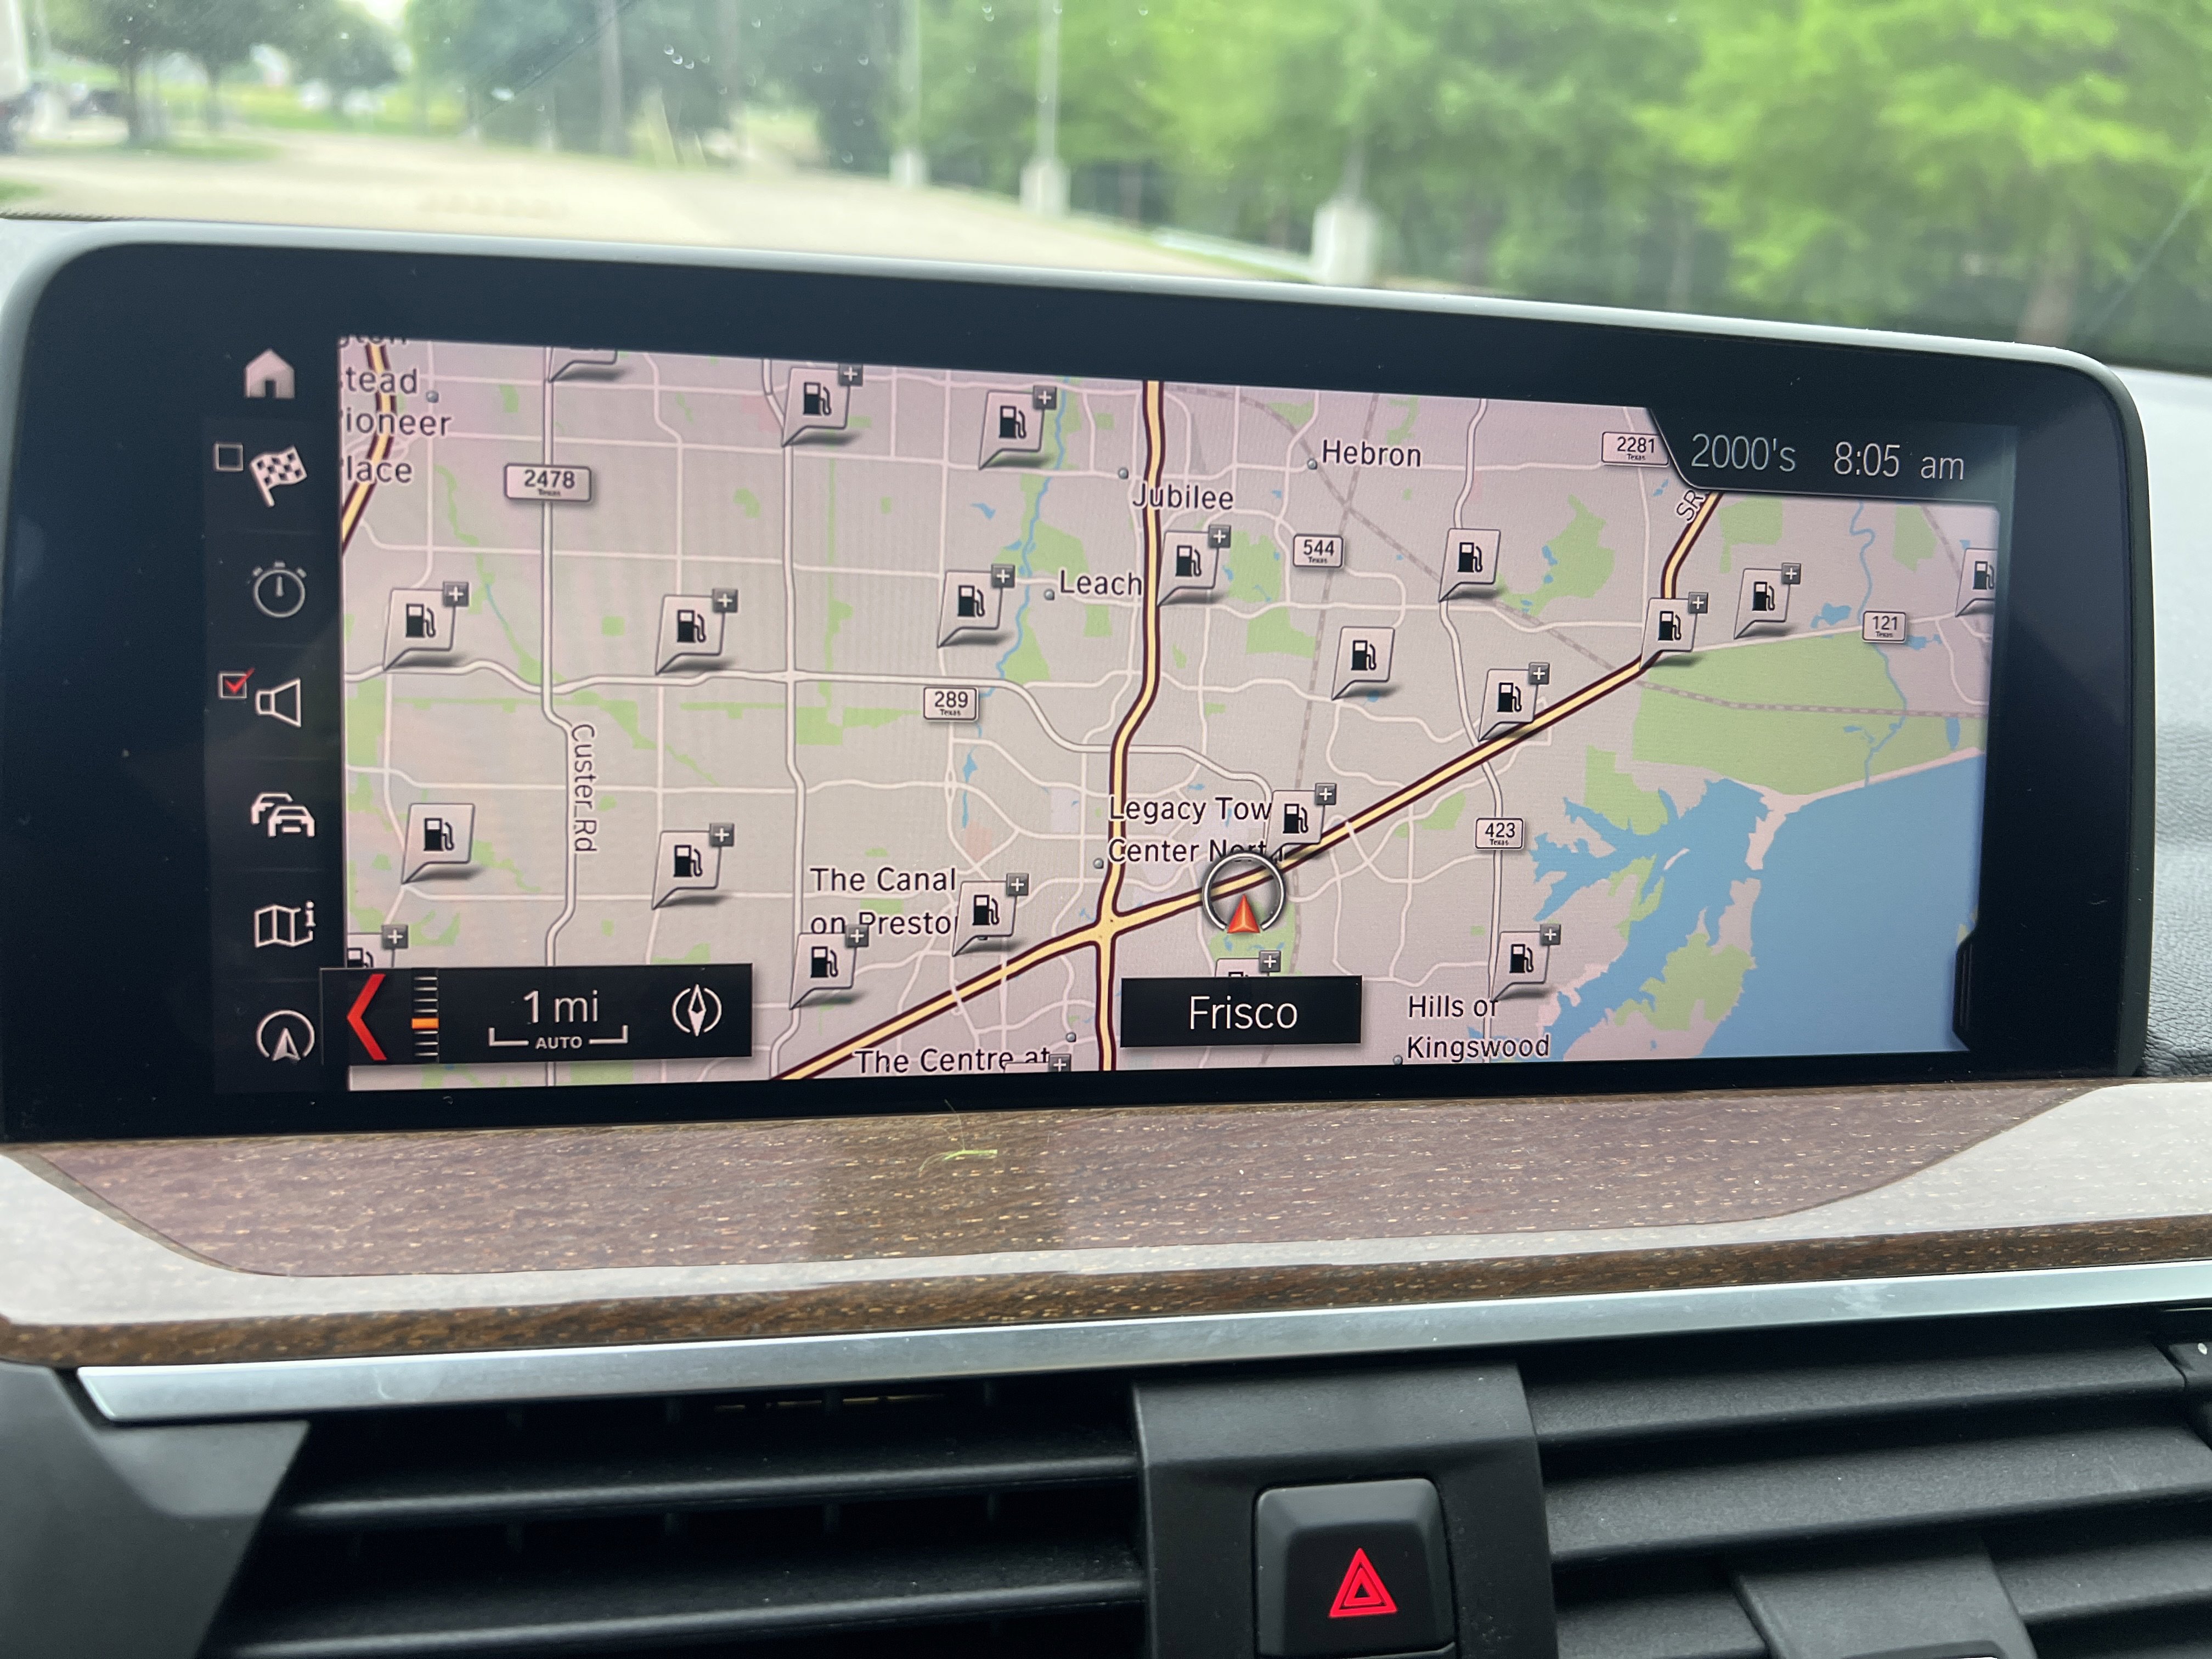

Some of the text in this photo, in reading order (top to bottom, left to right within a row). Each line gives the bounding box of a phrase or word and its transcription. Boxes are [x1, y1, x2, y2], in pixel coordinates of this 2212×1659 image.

[341, 366, 417, 394] tead
[341, 407, 452, 436] ioneer
[1323, 439, 1421, 467] Hebron
[1617, 436, 1655, 453] 2281
[1691, 433, 1796, 472] 2000's
[341, 455, 412, 483] lace
[1834, 441, 1964, 480] 8:05 am
[524, 469, 575, 489] 2478
[1133, 483, 1234, 510] Jubilee
[1304, 539, 1334, 556] 544
[1059, 569, 1143, 595] Leach
[1872, 616, 1897, 630] 121
[935, 691, 968, 708] 289
[572, 724, 597, 851] Custer Rd
[1109, 797, 1206, 824] Legacy
[1485, 822, 1515, 838] 423
[1109, 839, 1199, 862] Center
[810, 867, 956, 891] The Canal
[811, 912, 959, 934] on Presto
[523, 990, 597, 1023] 1 mi
[1189, 996, 1298, 1030] Frisco
[1408, 995, 1464, 1018] Hills
[535, 1036, 583, 1049] AUTO
[1408, 1034, 1550, 1063] Kingswood
[855, 1047, 1050, 1073] The Centre at
